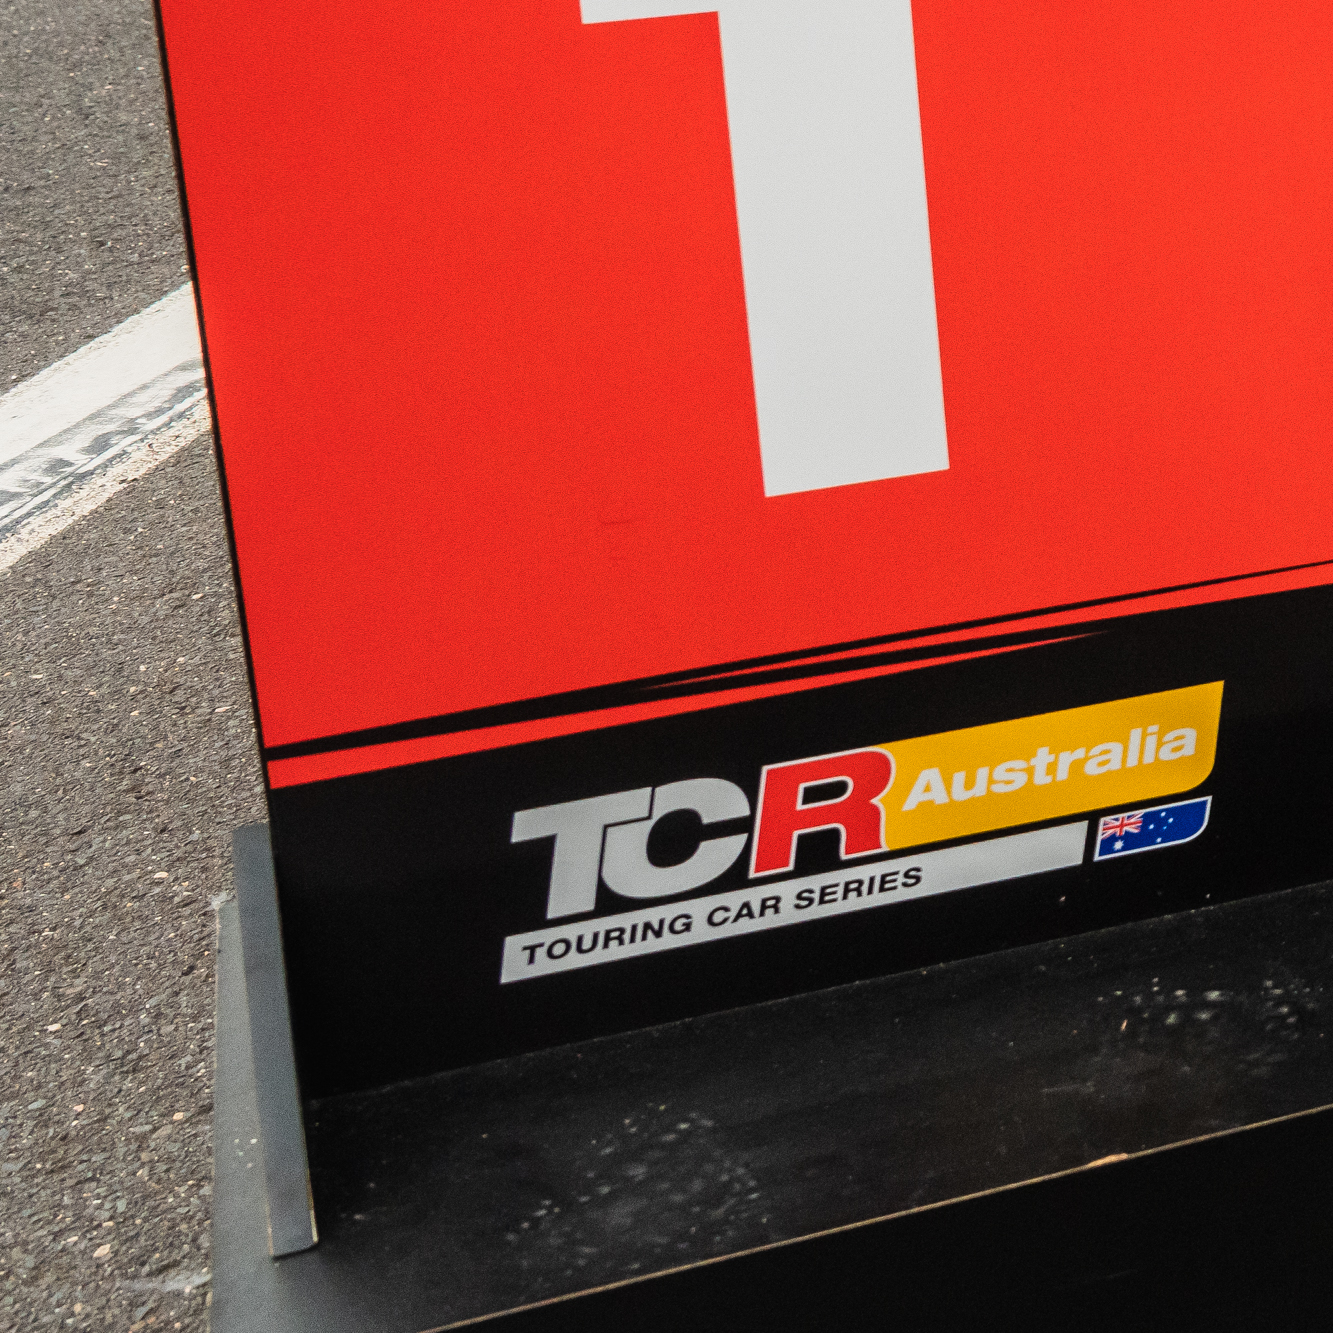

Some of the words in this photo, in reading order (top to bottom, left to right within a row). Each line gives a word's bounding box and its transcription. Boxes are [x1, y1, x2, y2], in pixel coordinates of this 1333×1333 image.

[510, 746, 896, 919] TCR
[900, 726, 1198, 812] Australia
[521, 913, 694, 966] TOURING
[706, 894, 782, 929] CAR
[792, 865, 925, 910] SERIES
